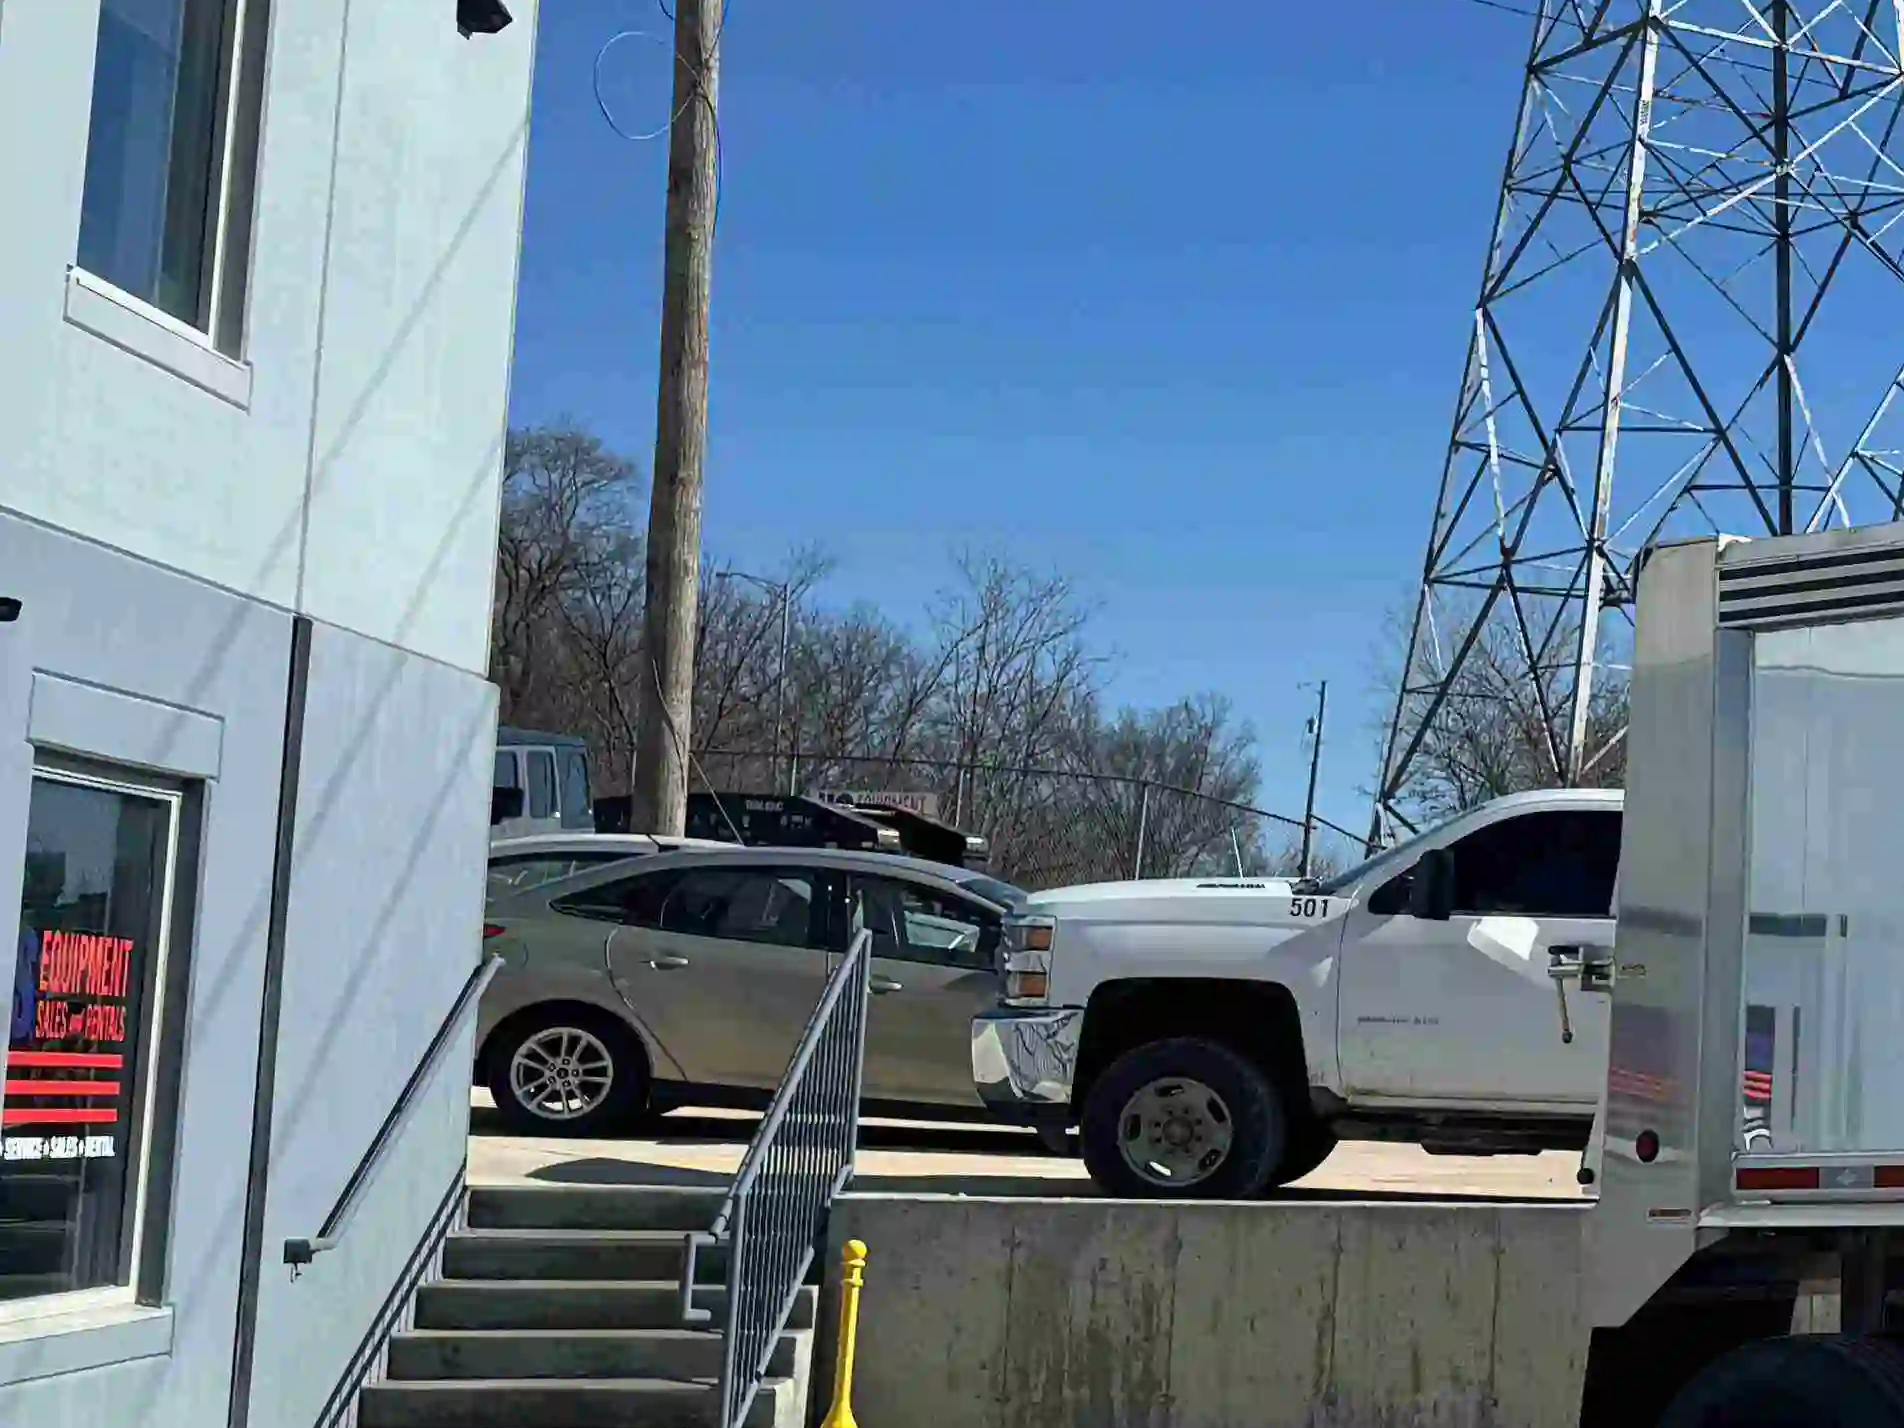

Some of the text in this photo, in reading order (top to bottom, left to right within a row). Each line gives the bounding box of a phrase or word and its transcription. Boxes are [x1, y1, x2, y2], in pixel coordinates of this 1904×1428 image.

[1289, 897, 1329, 918] 501
[39, 930, 134, 998] EQUIPMENT
[35, 999, 69, 1039] SALES
[84, 1003, 127, 1043] RENTALS
[49, 1135, 79, 1159] SALES
